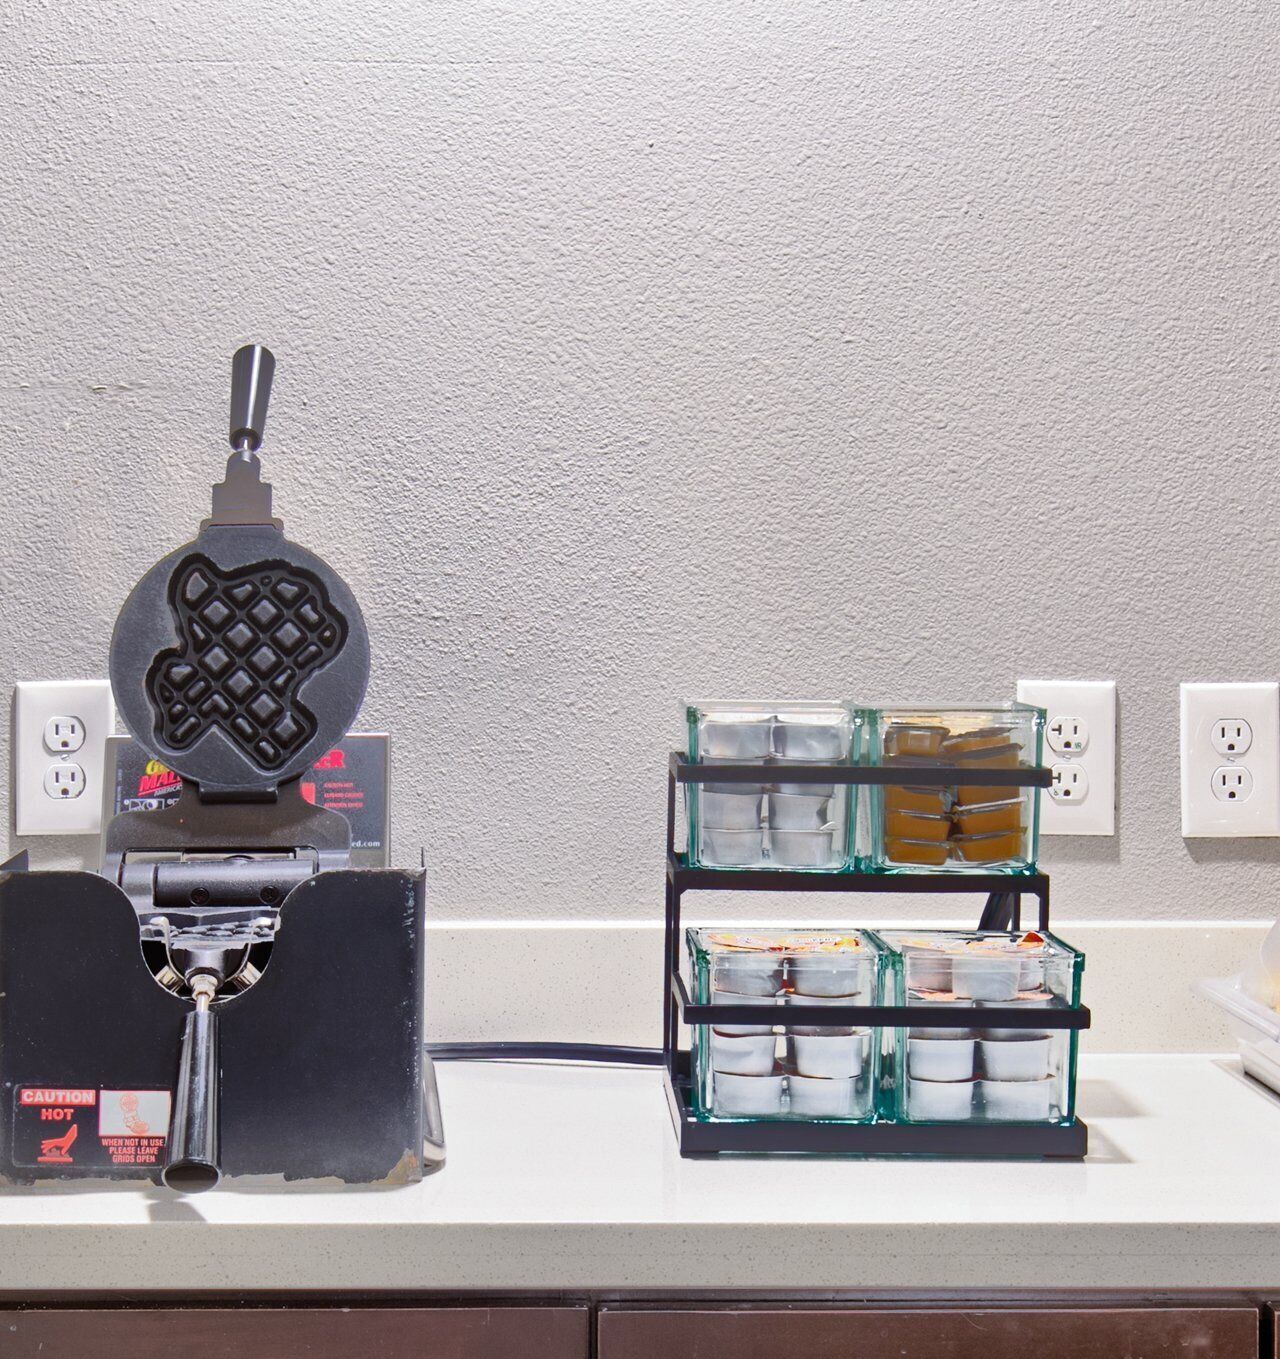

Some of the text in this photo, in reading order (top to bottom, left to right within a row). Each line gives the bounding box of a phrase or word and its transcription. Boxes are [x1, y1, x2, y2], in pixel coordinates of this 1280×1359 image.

[139, 771, 182, 792] MAL
[22, 1091, 94, 1103] CAUTION
[41, 1108, 74, 1121] HOT
[102, 1139, 123, 1147] WHEN
[124, 1139, 139, 1147] NOT
[140, 1139, 148, 1147] IN
[109, 1147, 158, 1155] PLEASE LEAVE
[112, 1155, 156, 1163] GRIDS OPEN
